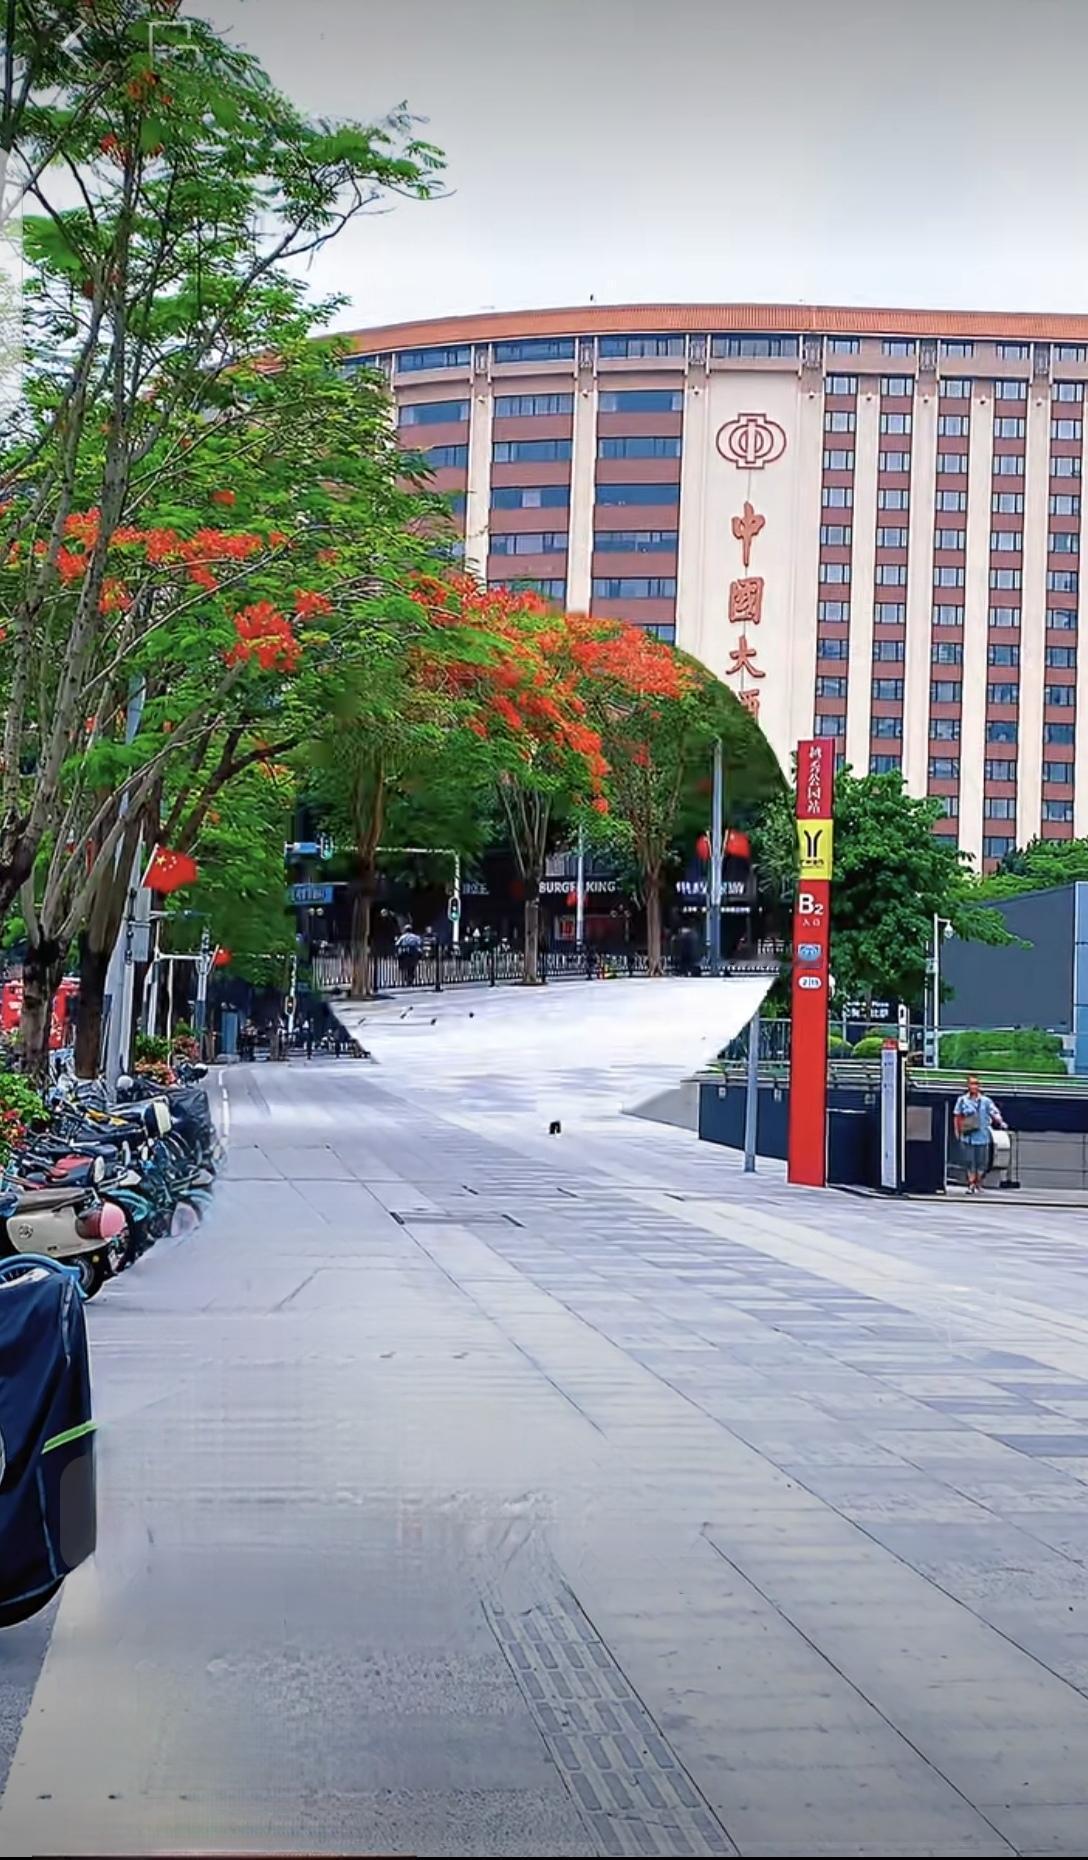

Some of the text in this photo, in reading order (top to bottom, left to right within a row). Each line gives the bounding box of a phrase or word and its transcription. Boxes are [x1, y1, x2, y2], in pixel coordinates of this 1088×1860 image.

[539, 881, 616, 893] BURGE KING
[798, 893, 824, 916] B2
